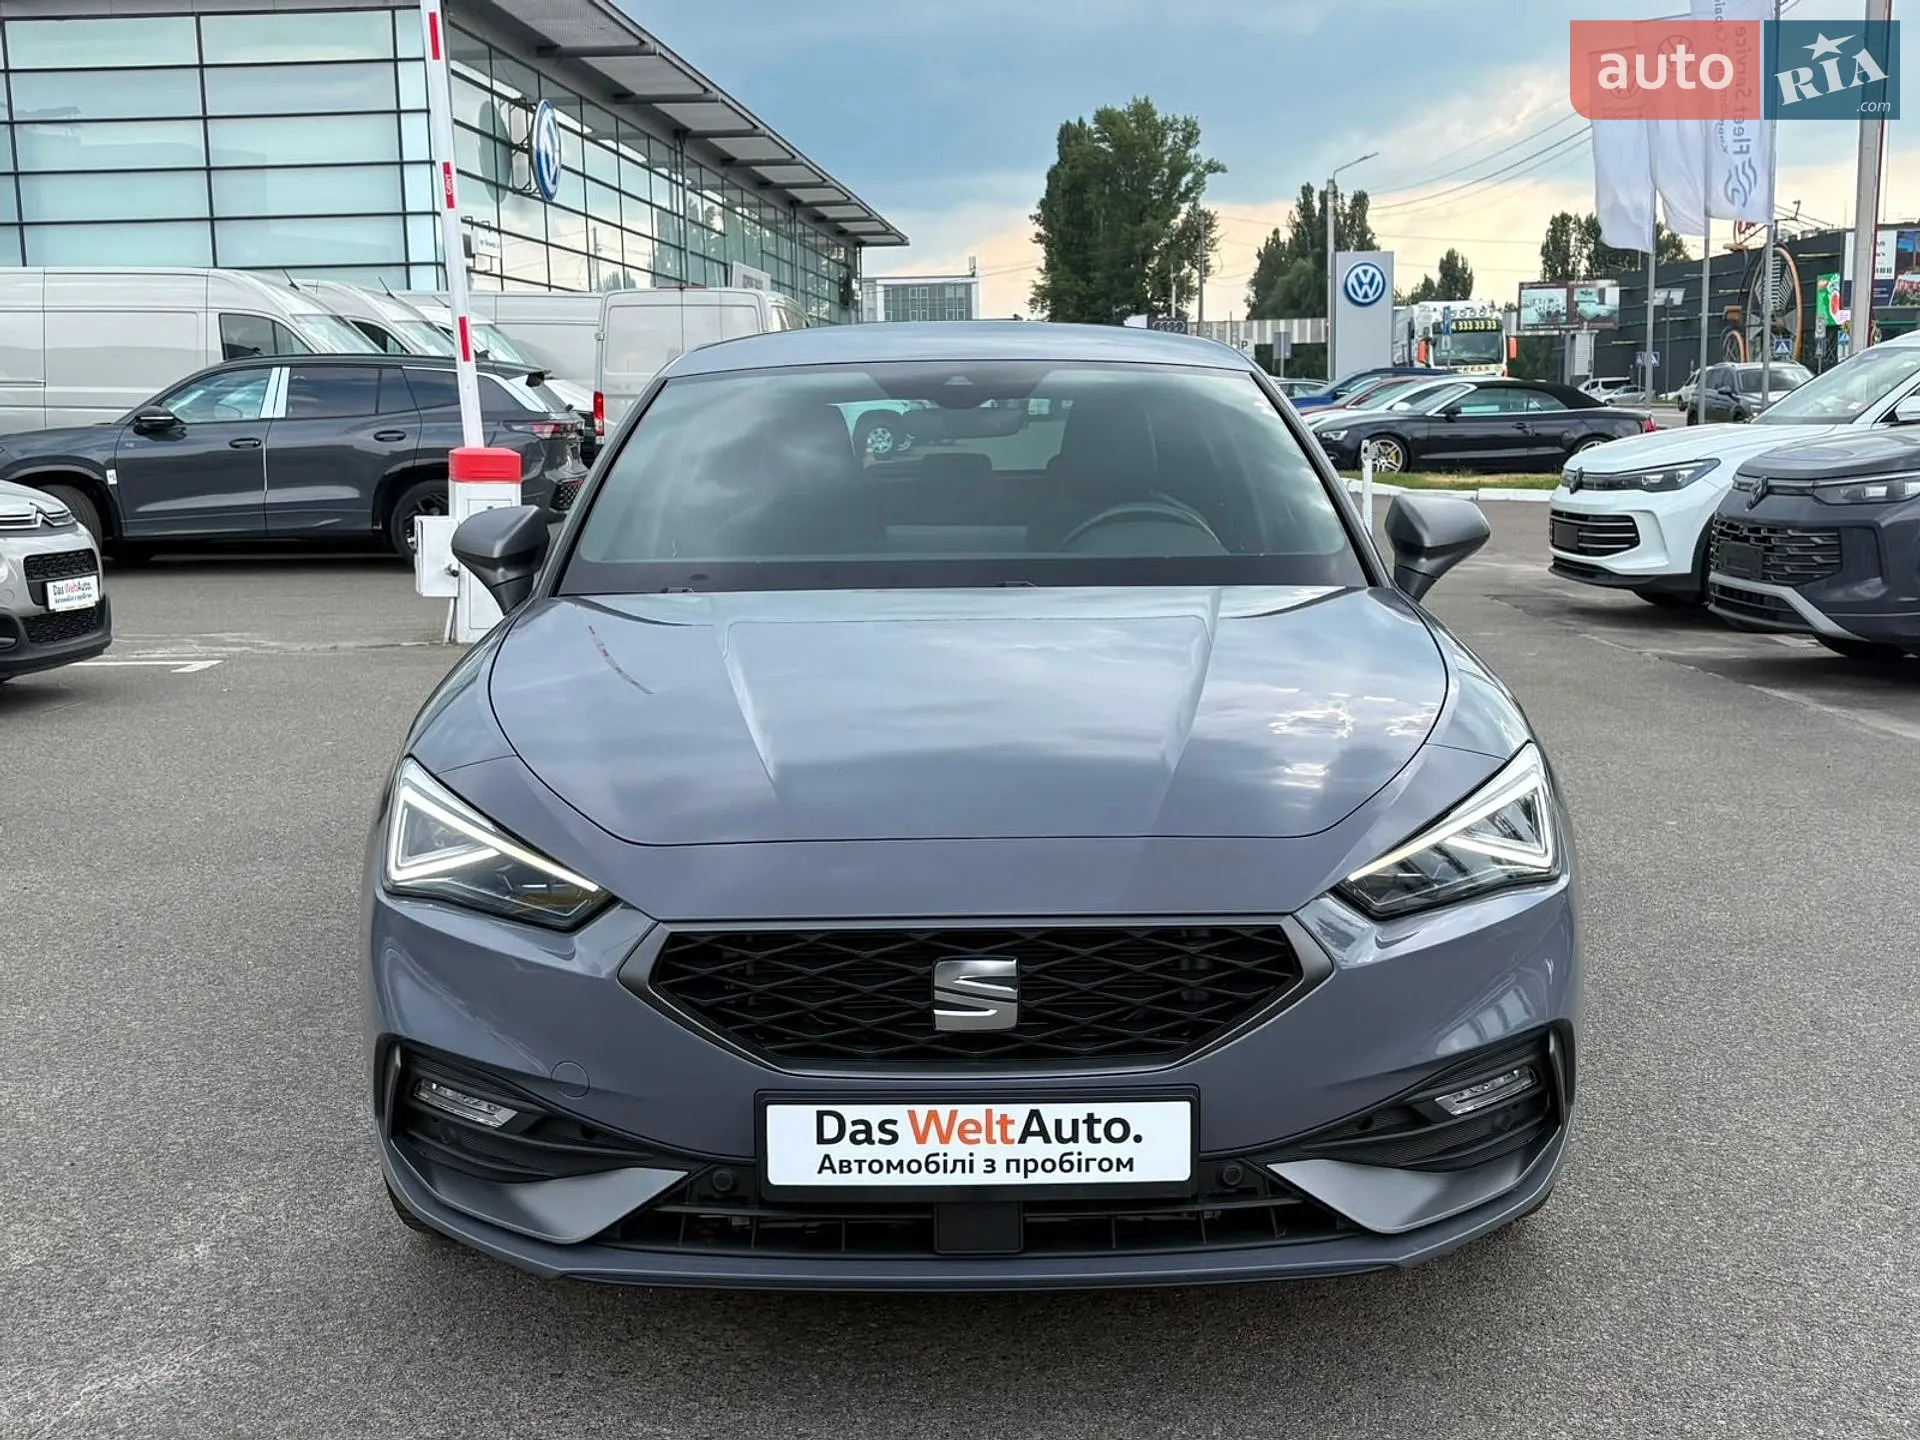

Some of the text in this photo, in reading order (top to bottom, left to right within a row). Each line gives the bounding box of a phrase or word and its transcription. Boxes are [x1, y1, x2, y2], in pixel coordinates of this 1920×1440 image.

[817, 1151, 1134, 1179] Автомобілі з пробігом
